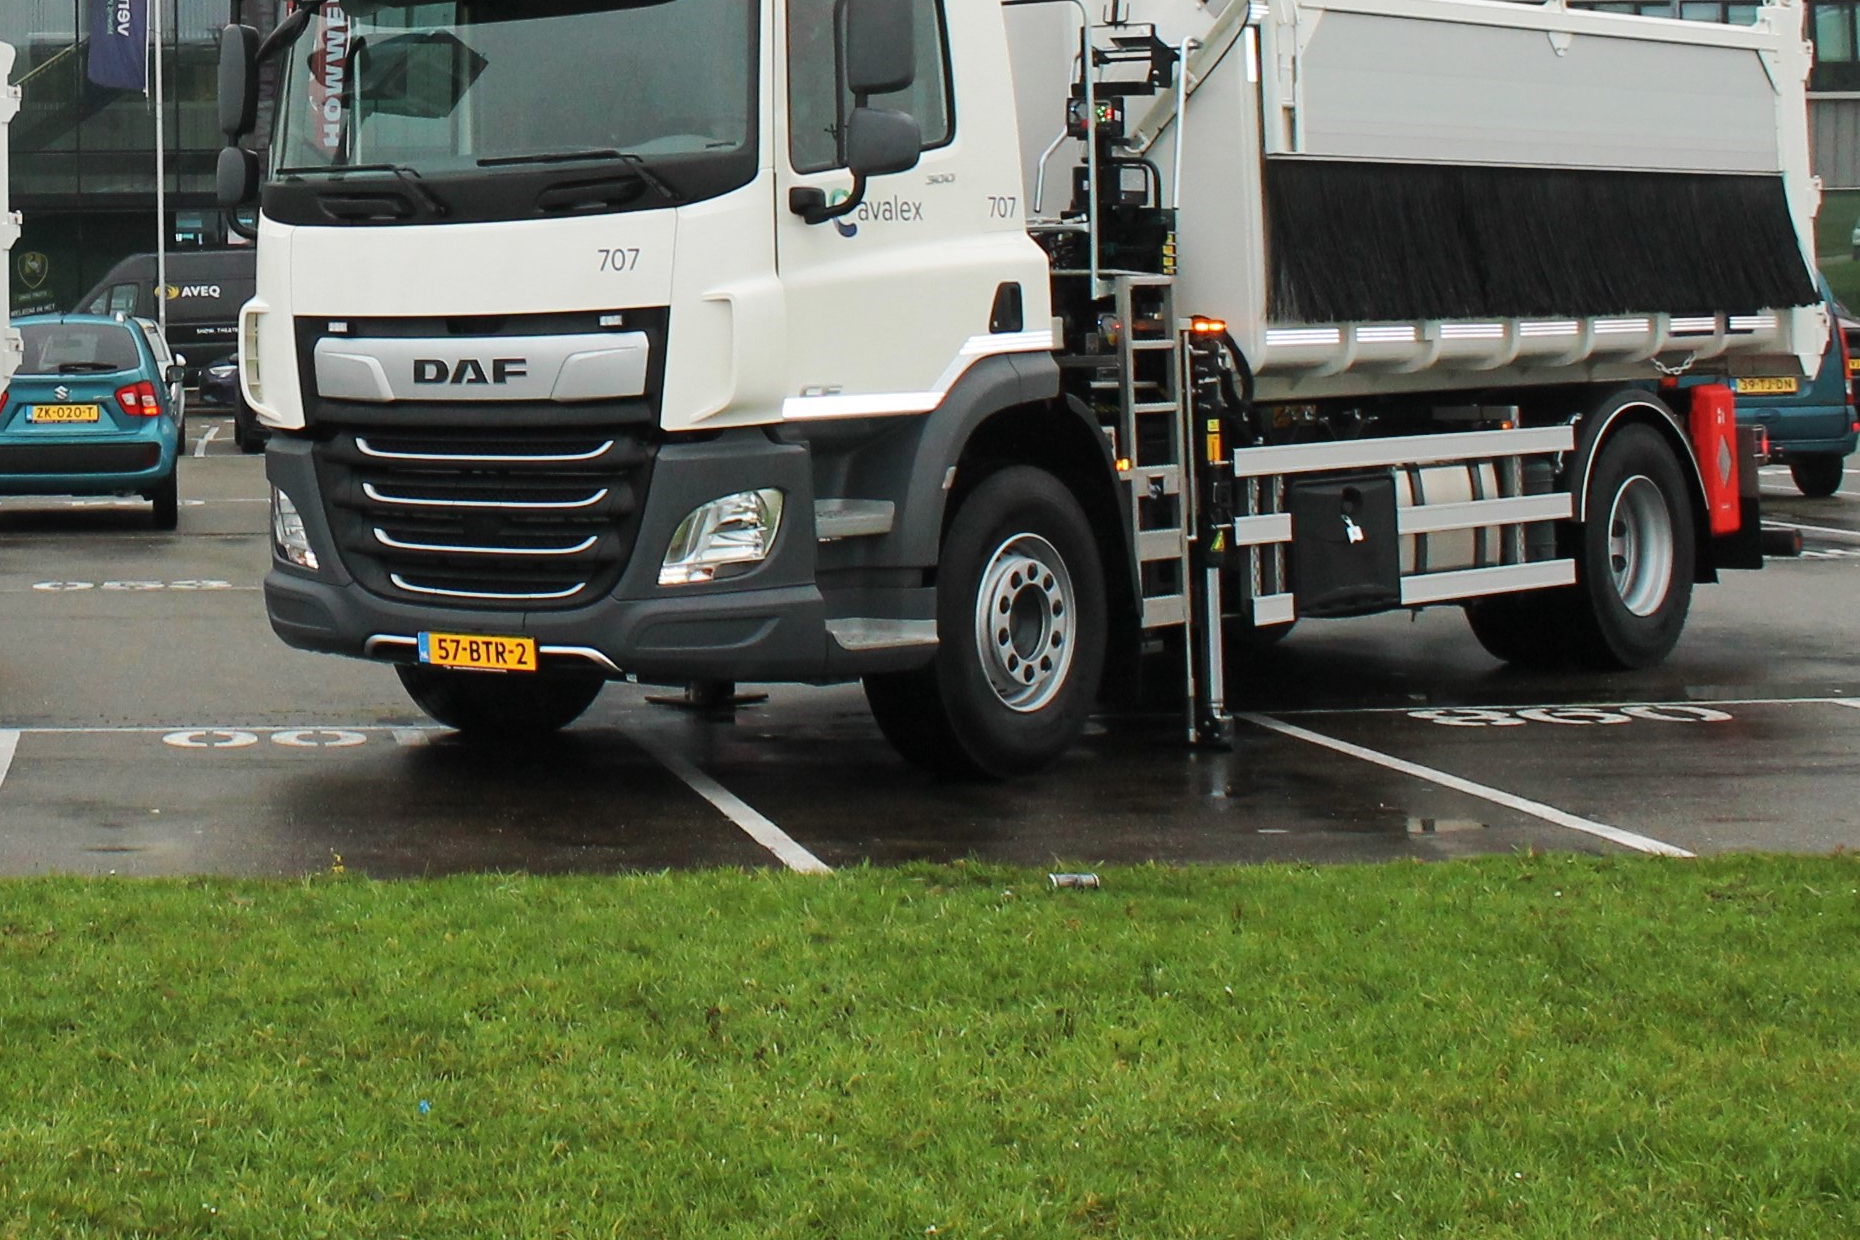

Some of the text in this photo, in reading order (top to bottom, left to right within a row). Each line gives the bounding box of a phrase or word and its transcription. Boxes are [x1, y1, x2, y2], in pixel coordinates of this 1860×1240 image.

[858, 195, 1016, 221] avalex 707
[597, 248, 641, 273] 707
[181, 285, 222, 299] AVEQ
[412, 357, 529, 386] DAF
[36, 406, 94, 419] ZK-020-T
[437, 638, 528, 666] 57-BTR-2
